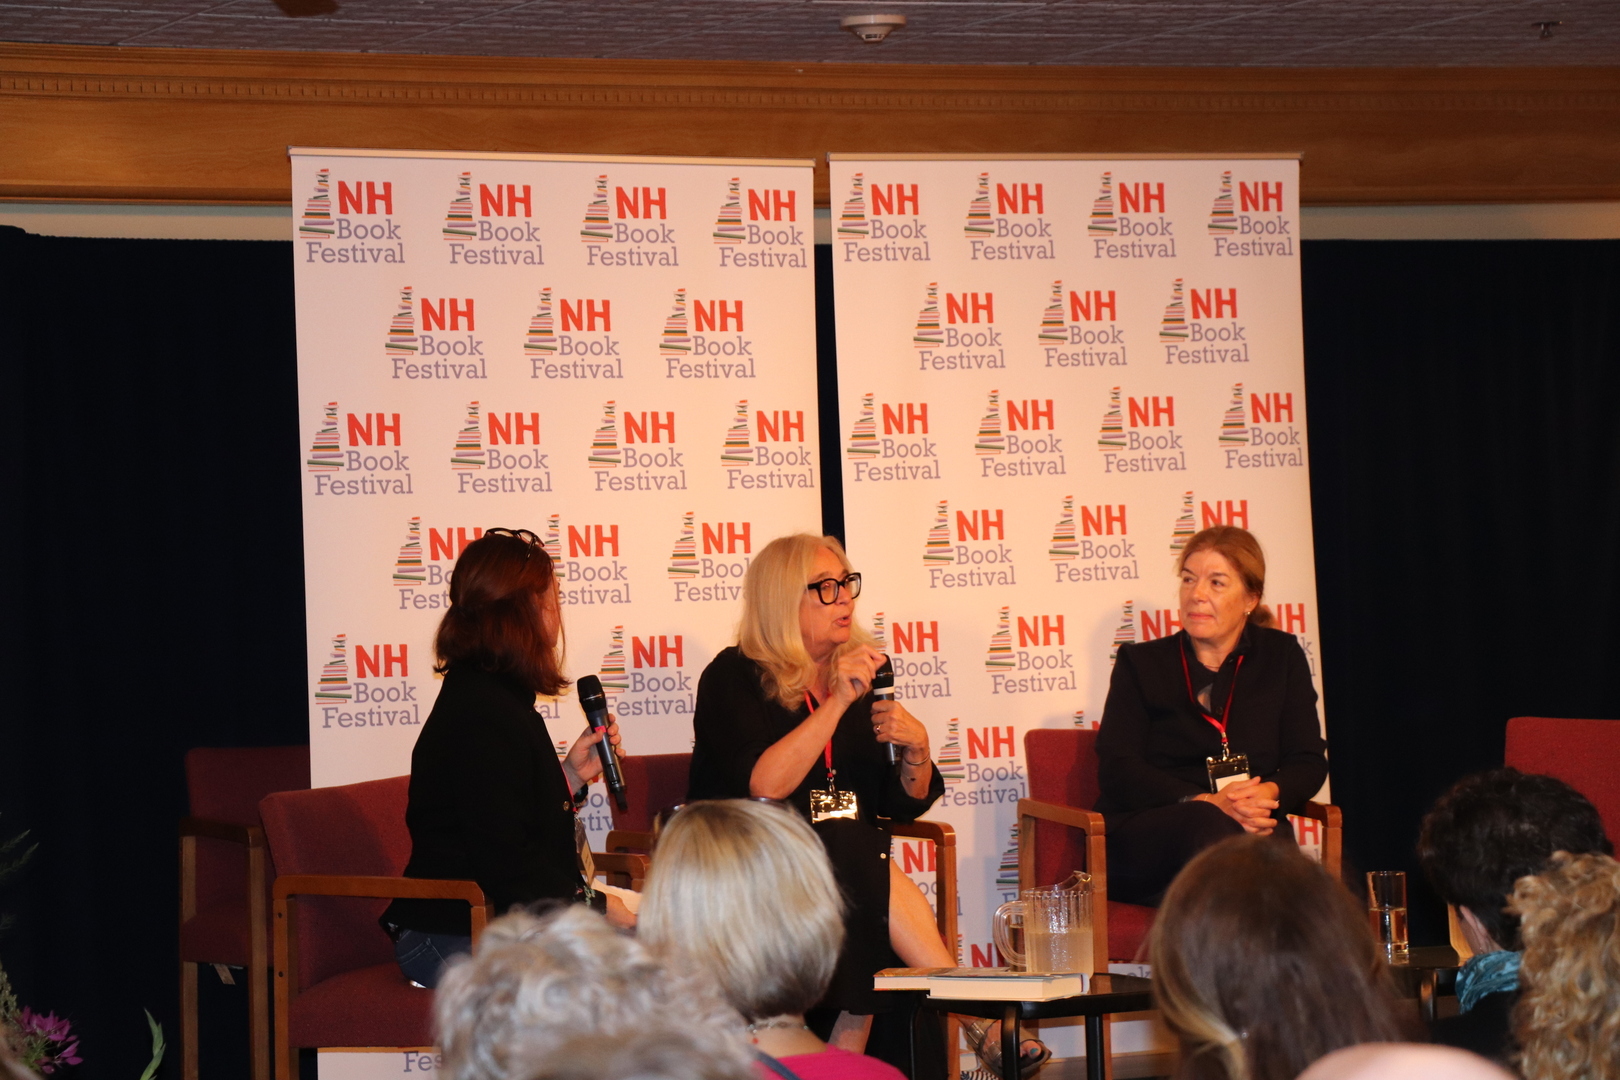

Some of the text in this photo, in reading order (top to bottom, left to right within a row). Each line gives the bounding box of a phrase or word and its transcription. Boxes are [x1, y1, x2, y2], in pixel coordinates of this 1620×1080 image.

[338, 181, 392, 215] NH
[480, 184, 531, 217] NH
[616, 187, 666, 219] NH
[748, 189, 795, 222] NH
[871, 184, 919, 215] NH
[997, 183, 1043, 214] NH
[1119, 183, 1165, 213] NH
[1239, 182, 1282, 212] NH
[336, 218, 401, 239] Book
[478, 220, 540, 242] Book
[614, 223, 675, 243] Book
[747, 224, 803, 245] Book
[870, 219, 927, 239] Book
[996, 218, 1052, 237] Book
[1118, 217, 1173, 236] Book
[1239, 215, 1290, 234] Book
[306, 242, 405, 263] Festival
[449, 243, 544, 265] Festival
[587, 245, 679, 266] Festival
[719, 247, 807, 268] Festival
[844, 241, 930, 262] Festival
[971, 240, 1055, 260] Festival
[1094, 238, 1176, 258] Festival
[1214, 237, 1293, 256] Festival
[421, 298, 474, 331] NH
[946, 293, 993, 324] NH
[1070, 291, 1116, 321] NH
[1191, 288, 1237, 319] NH
[560, 299, 611, 331] NH
[694, 300, 743, 332] NH
[945, 327, 1002, 347] Book
[1069, 325, 1124, 344] Book
[1190, 322, 1245, 342] Book
[420, 335, 483, 356] Book
[559, 335, 619, 356] Book
[693, 336, 752, 356] Book
[1045, 346, 1127, 367] Festival
[1165, 343, 1249, 364] Festival
[392, 358, 487, 379] Festival
[530, 358, 623, 379] Festival
[666, 358, 756, 378] Festival
[919, 349, 1005, 370] Festival
[882, 403, 928, 435] NH
[1007, 400, 1054, 431] NH
[1129, 396, 1174, 427] NH
[1251, 393, 1293, 423] NH
[347, 413, 401, 446] NH
[488, 412, 540, 445] NH
[624, 412, 675, 444] NH
[757, 411, 804, 442] NH
[1250, 426, 1300, 446] Book
[882, 438, 936, 458] Book
[1006, 434, 1062, 454] Book
[1128, 430, 1182, 450] Book
[346, 450, 409, 471] Book
[487, 449, 548, 469] Book
[623, 447, 683, 467] Book
[755, 446, 811, 465] Book
[981, 455, 1066, 477] Festival
[1104, 452, 1186, 472] Festival
[1225, 447, 1303, 468] Festival
[595, 470, 687, 491] Festival
[727, 468, 814, 489] Festival
[854, 460, 940, 481] Festival
[314, 474, 413, 496] Festival
[457, 472, 552, 493] Festival
[957, 510, 1004, 541] NH
[1081, 505, 1126, 536] NH
[1201, 500, 1248, 530] NH
[568, 525, 619, 557] NH
[702, 522, 751, 554] NH
[1081, 539, 1135, 559] Book
[956, 544, 1012, 564] Book
[427, 564, 451, 585] Bo
[567, 561, 627, 581] Book
[701, 557, 750, 578] Boo
[929, 566, 1016, 588] Festival
[1055, 560, 1139, 582] Festival
[399, 588, 450, 610] Fest
[559, 583, 632, 605] estival
[674, 580, 742, 602] Festiv
[893, 621, 939, 654] NH
[1018, 615, 1064, 647] NH
[355, 644, 408, 678] NH
[632, 635, 683, 669] NH
[1017, 649, 1073, 670] Book
[892, 655, 948, 678] Book
[354, 681, 416, 703] Book
[631, 671, 691, 693] Book
[894, 677, 951, 700] stival
[991, 671, 1076, 694] Festival
[322, 704, 420, 728] Festival
[605, 692, 695, 718] Festival
[967, 726, 1015, 759] NH
[966, 761, 1023, 783] Book
[941, 782, 1028, 807] Festival
[1289, 816, 1320, 846] H
